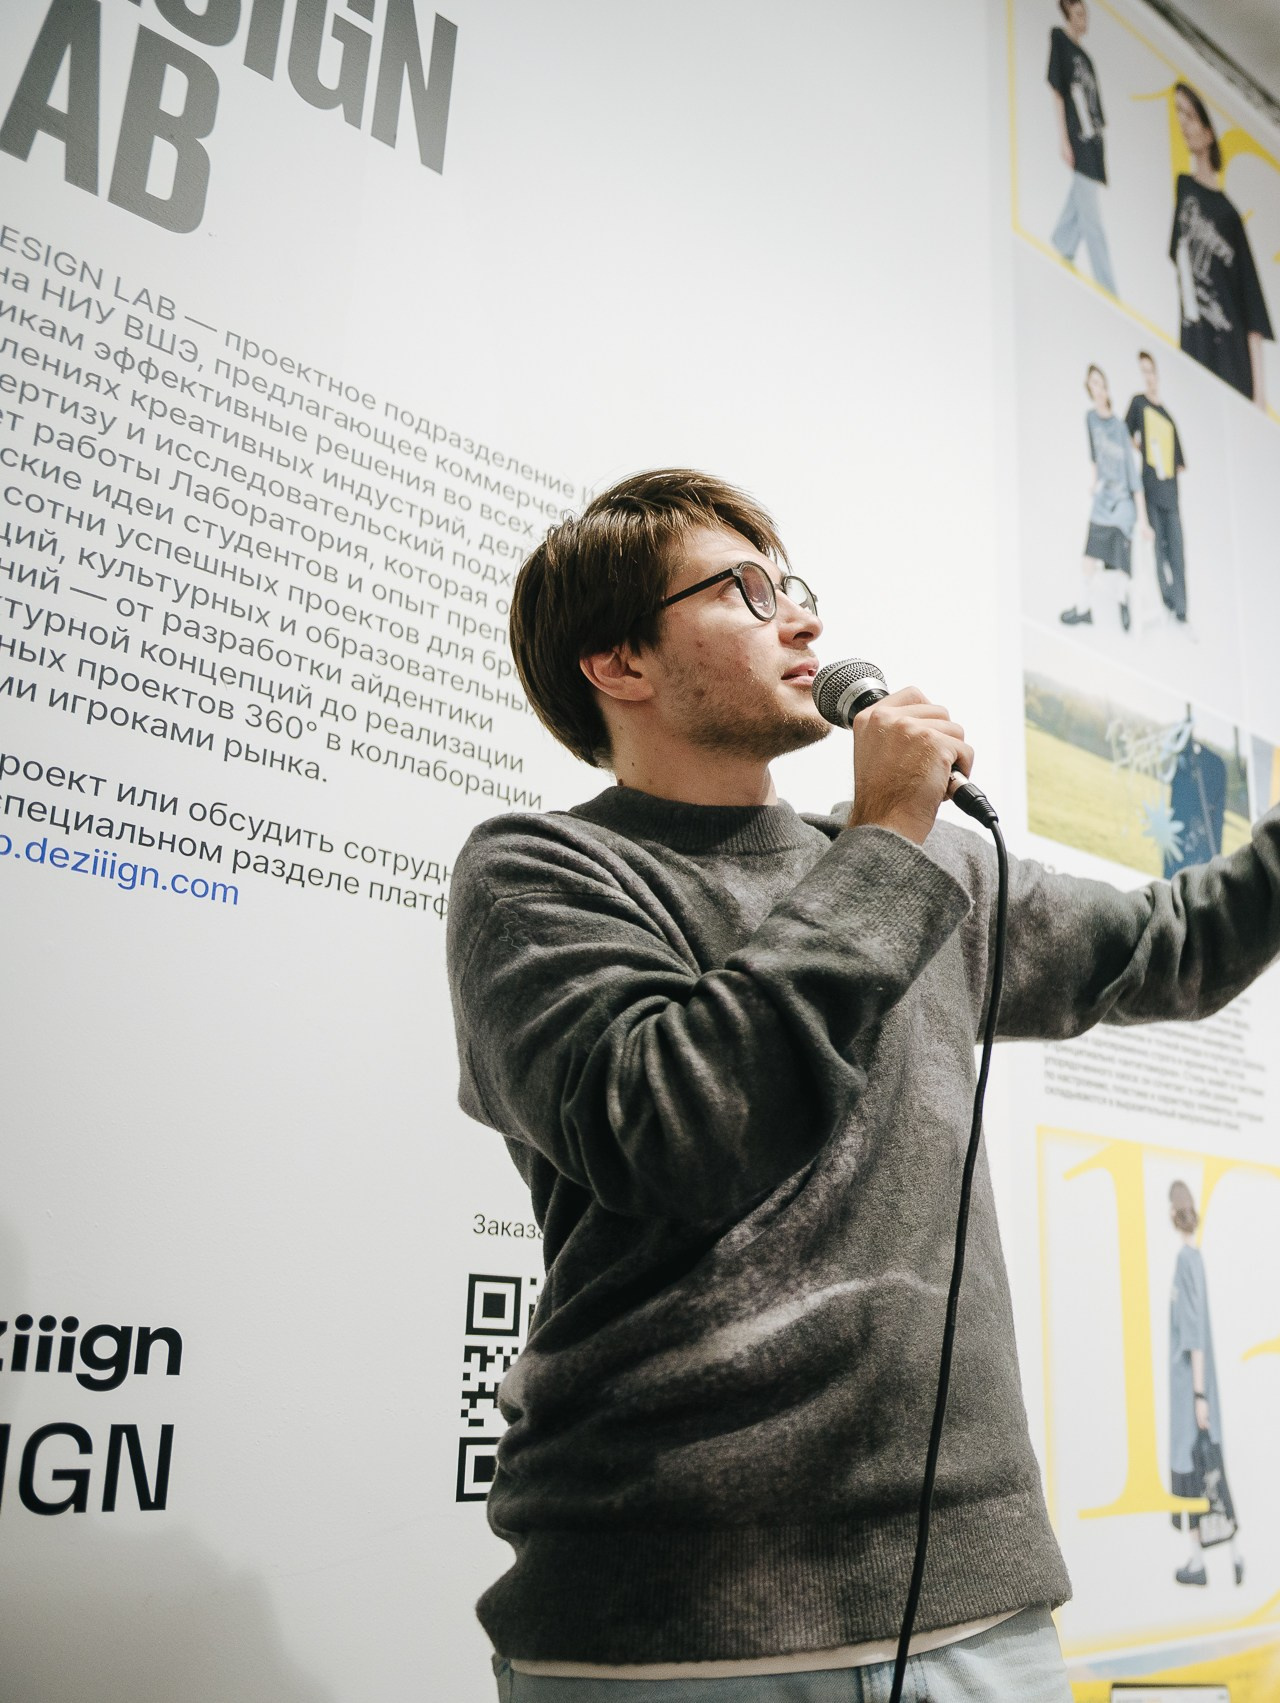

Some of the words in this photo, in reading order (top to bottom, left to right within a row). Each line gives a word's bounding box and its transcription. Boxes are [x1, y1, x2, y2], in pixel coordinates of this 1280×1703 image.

[0, 337, 121, 401] лениях
[130, 390, 314, 478] креативных
[323, 468, 471, 546] индустрий,
[41, 278, 116, 324] НИУ
[124, 314, 203, 372] ВШЭ,
[215, 358, 427, 463] предлагающее
[94, 342, 307, 442] эффективные
[316, 434, 435, 497] решения
[444, 488, 471, 511] во
[480, 503, 533, 538] всех
[114, 276, 176, 321] LAB
[225, 331, 376, 410] проектное
[385, 402, 574, 498] подразделение
[0, 373, 118, 435] ертизу
[127, 422, 145, 445] и
[155, 434, 444, 561] исследовательский
[452, 551, 512, 586] подх
[0, 409, 24, 431] т
[33, 422, 160, 485] работы
[169, 470, 374, 570] Лаборатория,
[384, 555, 487, 608] которая
[0, 448, 82, 490] ские
[92, 480, 174, 525] идеи
[184, 515, 338, 584] студентов
[348, 573, 363, 593] и
[372, 584, 439, 619] опыт
[3, 486, 106, 536] сотни
[115, 523, 279, 597] успешных
[288, 584, 419, 645] проектов
[426, 635, 474, 664] для
[482, 650, 519, 679] бр
[78, 547, 271, 628] культурных
[280, 615, 296, 636] и
[306, 625, 533, 715] образовательны
[116, 598, 154, 623] от
[162, 611, 342, 685] разработки
[351, 673, 493, 733] айдентики
[0, 596, 130, 654] турной
[140, 640, 312, 709] концепций
[320, 697, 357, 722] до
[366, 710, 523, 773] реализации
[49, 688, 214, 751] игроками
[224, 737, 327, 783] рынка.
[77, 658, 234, 720] проектов
[245, 704, 317, 739] 360°
[326, 732, 341, 751] в
[351, 739, 541, 810] коллаборации
[0, 793, 223, 864] пециальном
[232, 848, 359, 895] разделе
[117, 783, 178, 816] или
[189, 802, 334, 853] обсудить
